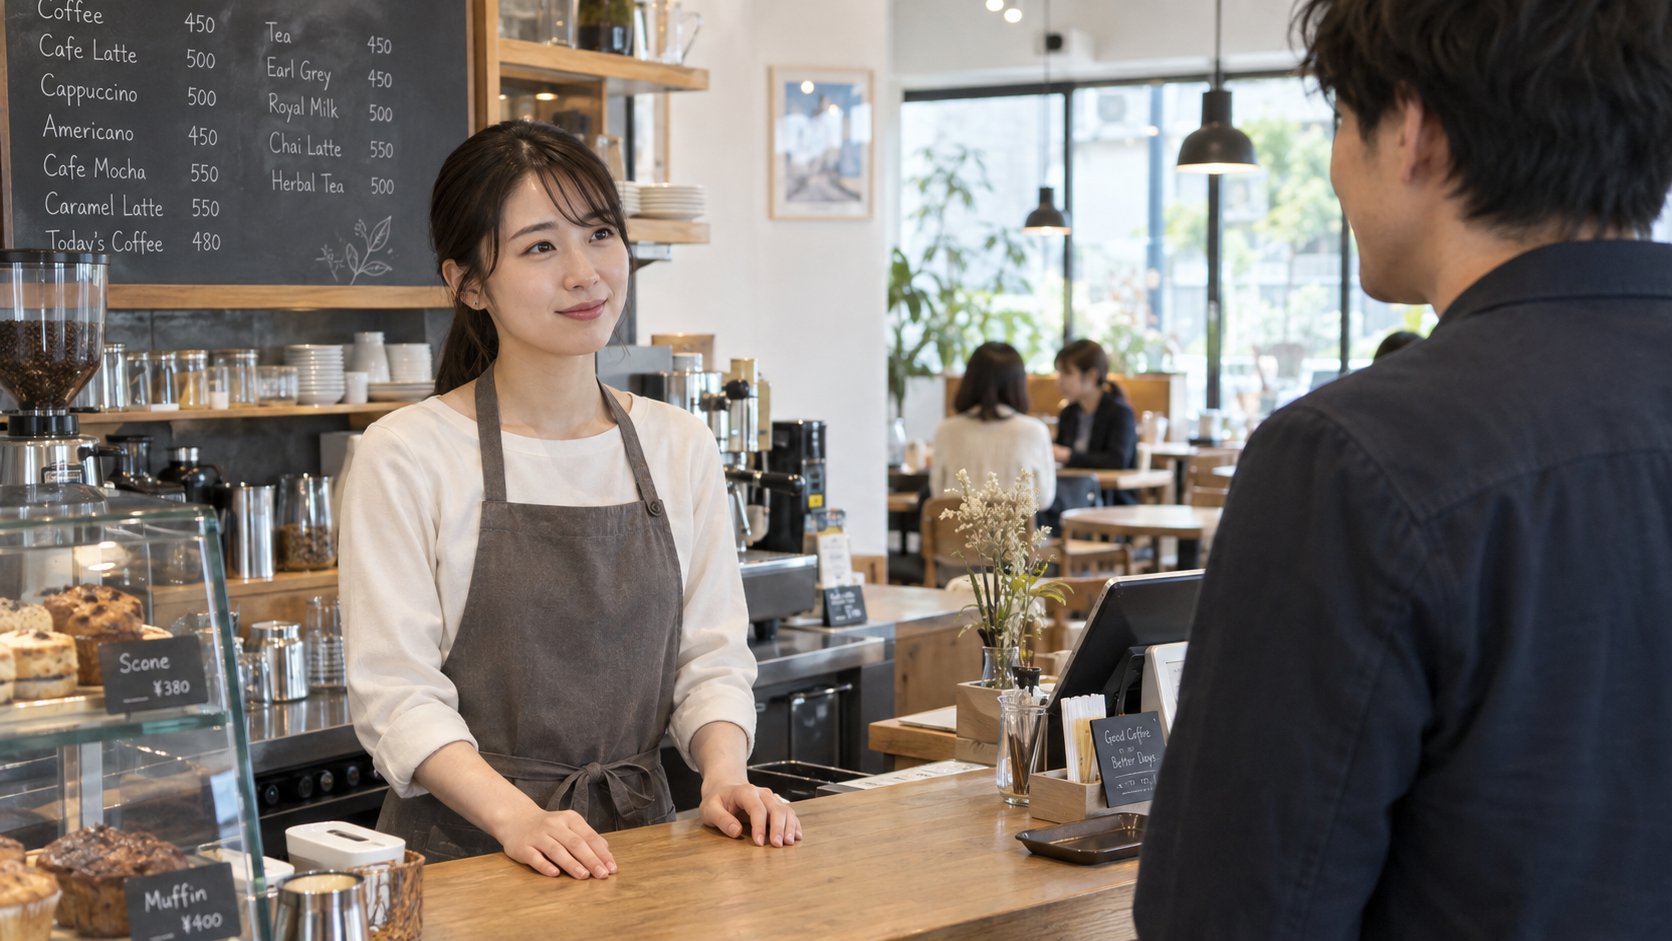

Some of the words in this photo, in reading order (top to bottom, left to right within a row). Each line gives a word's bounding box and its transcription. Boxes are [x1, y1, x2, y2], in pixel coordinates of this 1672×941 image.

[38, 0, 104, 25] Coffee
[184, 12, 216, 34] 450
[38, 33, 84, 61] Cafe
[92, 38, 138, 64] Latte
[186, 48, 216, 69] 500
[265, 21, 292, 44] Tea
[367, 36, 393, 55] 450
[266, 57, 295, 79] Earl
[299, 60, 332, 91] Grey
[367, 69, 393, 89] 450
[40, 73, 138, 107] Cappuccino
[187, 86, 217, 107] 500
[268, 93, 305, 123] Royal
[310, 97, 339, 120] Milk
[369, 103, 393, 123] 500
[42, 114, 134, 142] Americano
[188, 125, 218, 147] 450
[269, 131, 302, 155] Chai
[307, 134, 342, 158] Latte
[370, 141, 394, 159] 550
[43, 153, 86, 180] Cafe
[93, 157, 147, 181] Mocha
[190, 163, 219, 183] 550
[271, 170, 316, 194] Herbal
[320, 173, 345, 194] Tea
[371, 177, 395, 195] 500
[44, 191, 115, 217] Caramel
[122, 194, 164, 217] Latte
[191, 198, 220, 218] 550
[45, 229, 105, 252] Today's
[111, 230, 164, 255] Coffee
[191, 231, 221, 252] 480
[119, 652, 170, 673] Scone
[153, 679, 190, 696] ¥380
[145, 882, 208, 913] Muffin
[181, 912, 223, 934] ¥400
